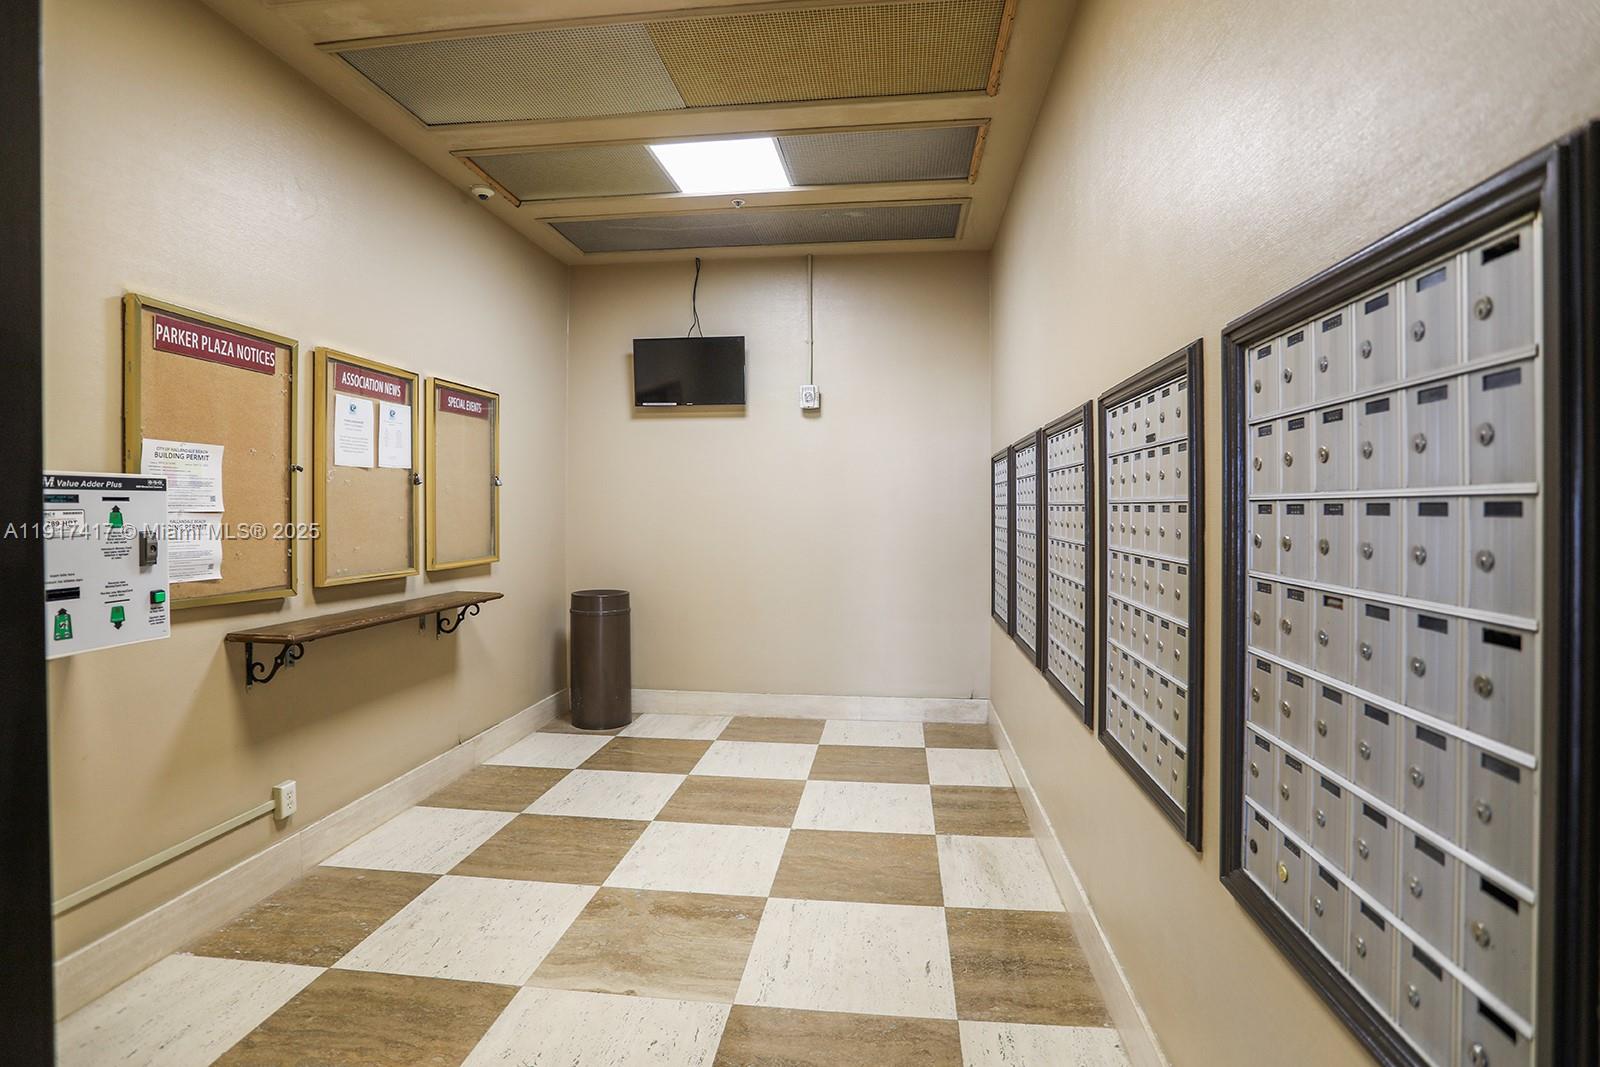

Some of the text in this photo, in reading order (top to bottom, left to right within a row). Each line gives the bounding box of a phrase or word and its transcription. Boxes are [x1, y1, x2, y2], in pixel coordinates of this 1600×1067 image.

[156, 323, 275, 367] PARKER PLAZA NOTICES
[341, 371, 401, 397] ASSOCIATION NEWS
[447, 395, 482, 413] SPECIAL EVENTS
[154, 451, 209, 461] BUILDING PERMIT
[57, 479, 80, 488] Value
[80, 480, 105, 488] Adder
[105, 480, 122, 488] Plus
